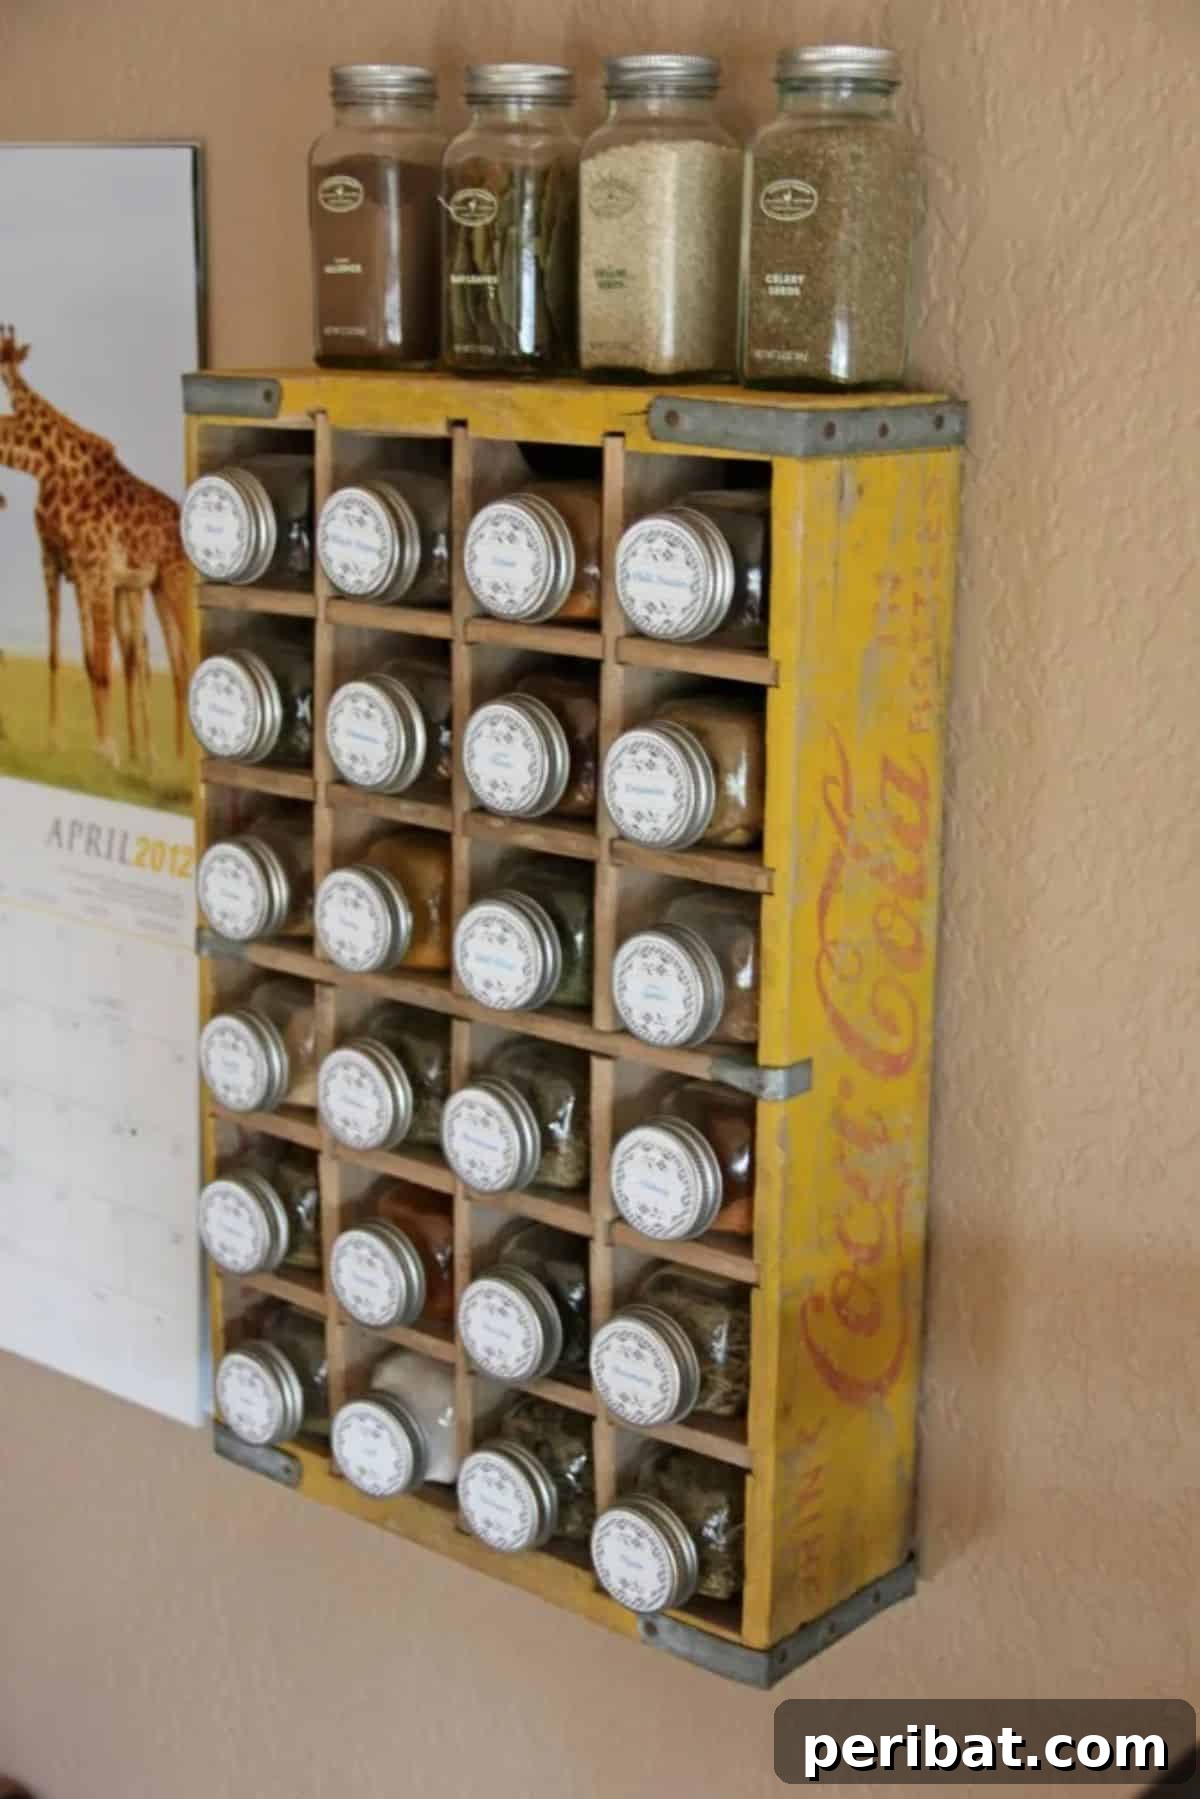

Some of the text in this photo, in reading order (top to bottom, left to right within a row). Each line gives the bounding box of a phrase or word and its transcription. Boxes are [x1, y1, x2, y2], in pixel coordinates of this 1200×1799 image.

[765, 272, 806, 285] CELERY
[44, 816, 196, 878] APRIL 2012
